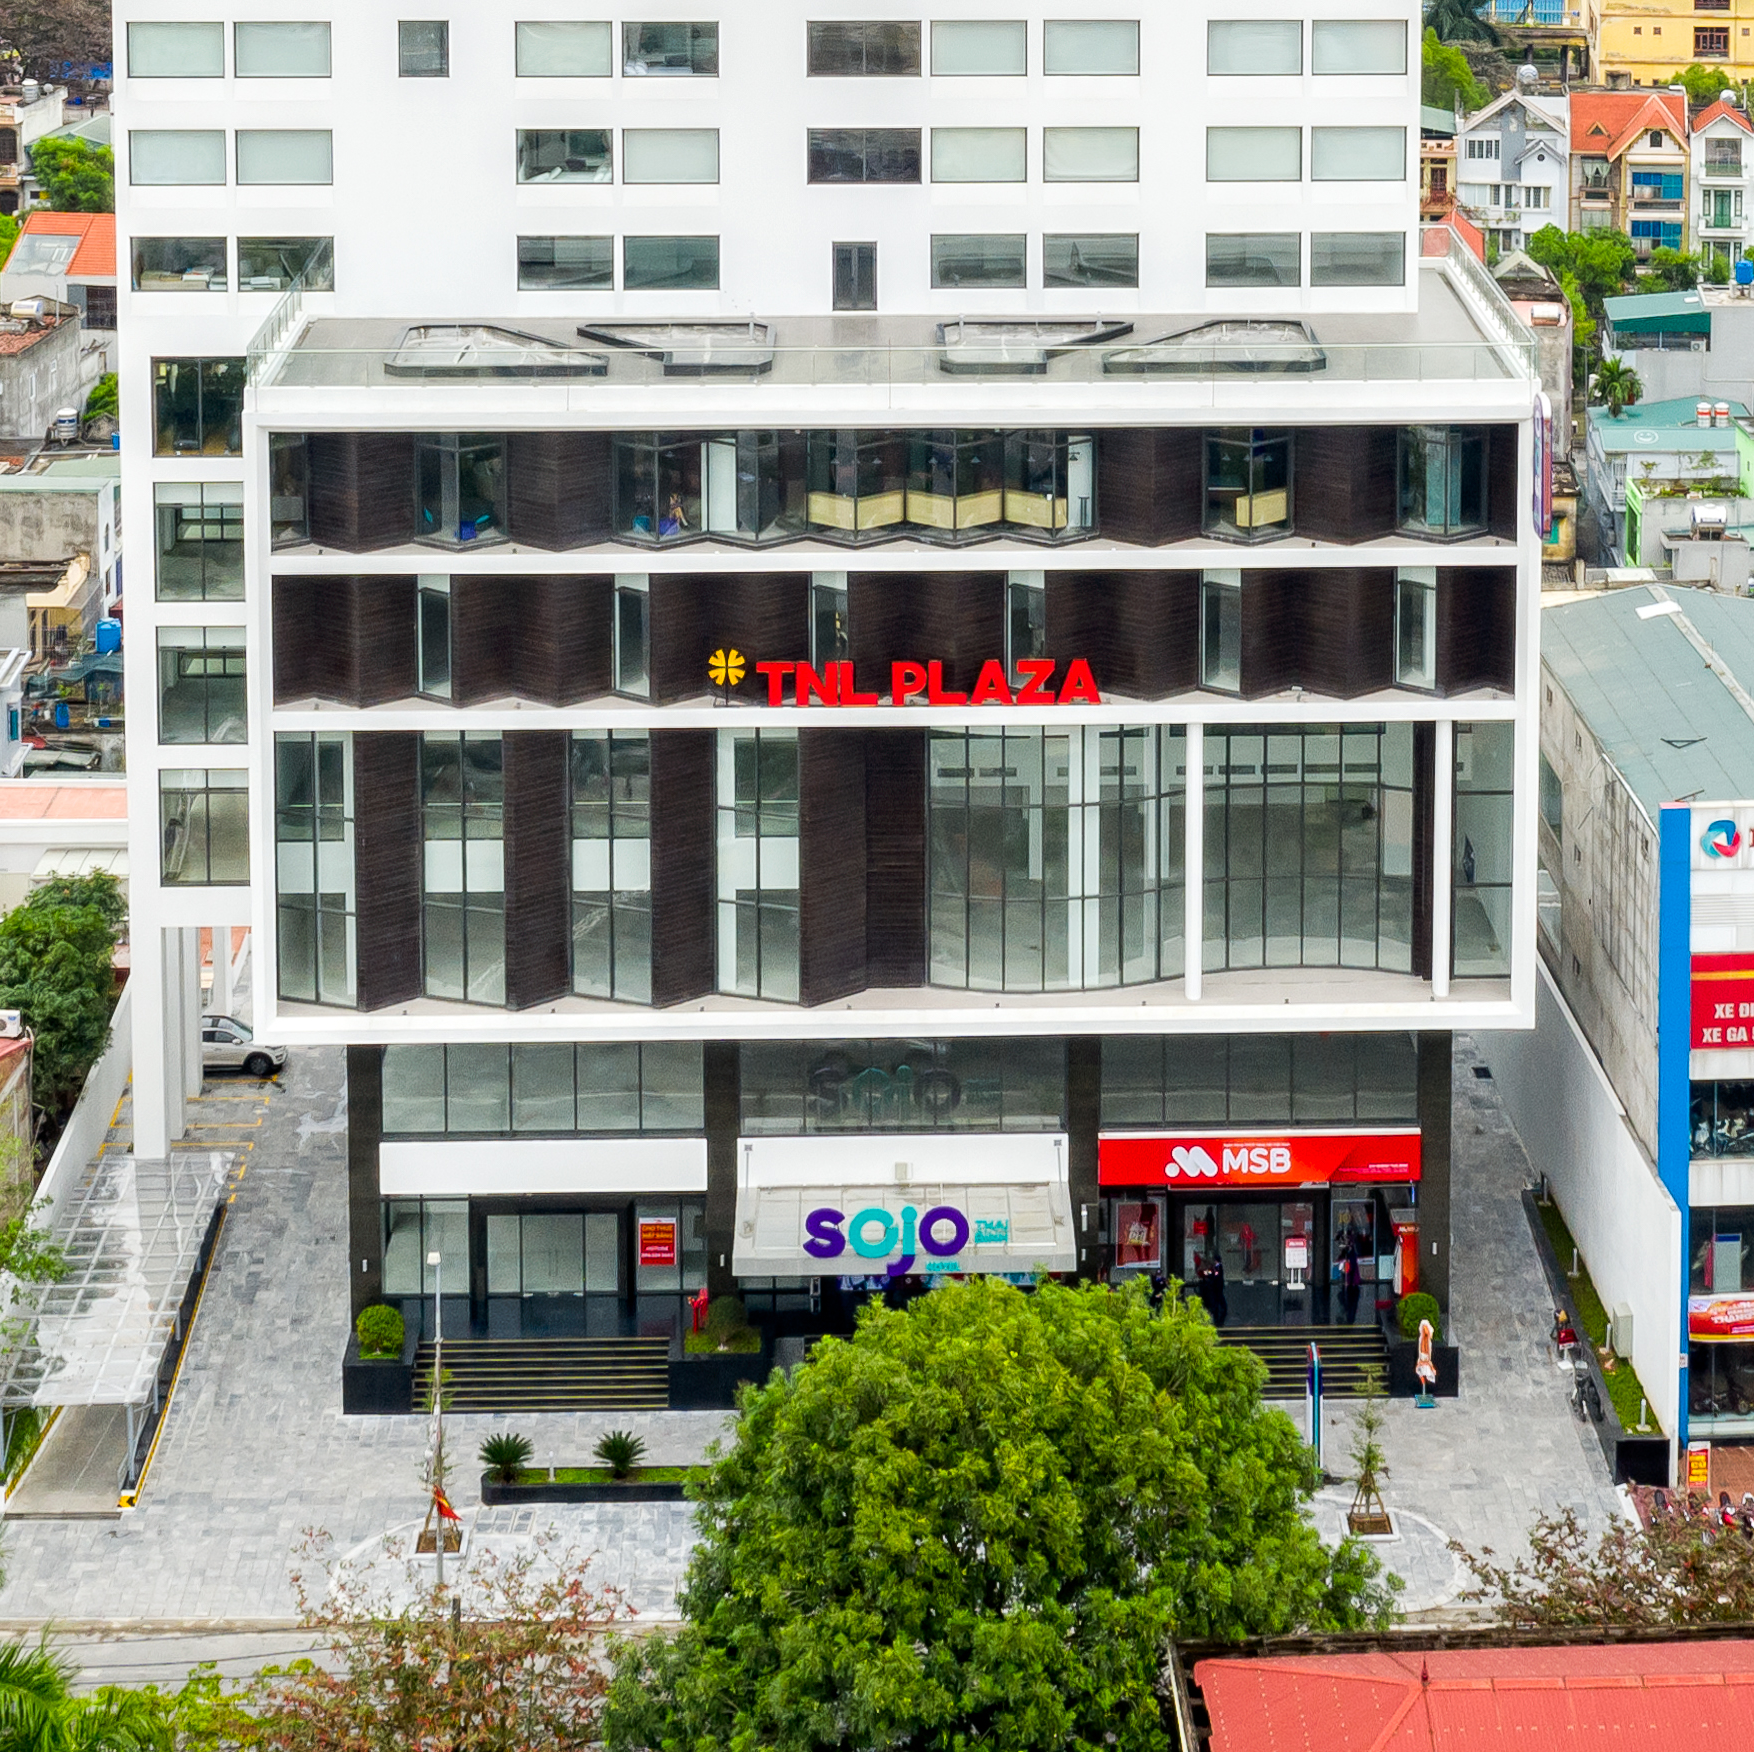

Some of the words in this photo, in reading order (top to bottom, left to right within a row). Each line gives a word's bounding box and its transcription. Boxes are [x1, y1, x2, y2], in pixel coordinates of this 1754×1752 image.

[756, 660, 879, 707] TNL
[891, 659, 1101, 706] PLAZA
[1714, 1003, 1735, 1019] XE
[1702, 1027, 1722, 1043] XE
[1726, 1026, 1748, 1042] GA
[1222, 1148, 1291, 1174] MSB
